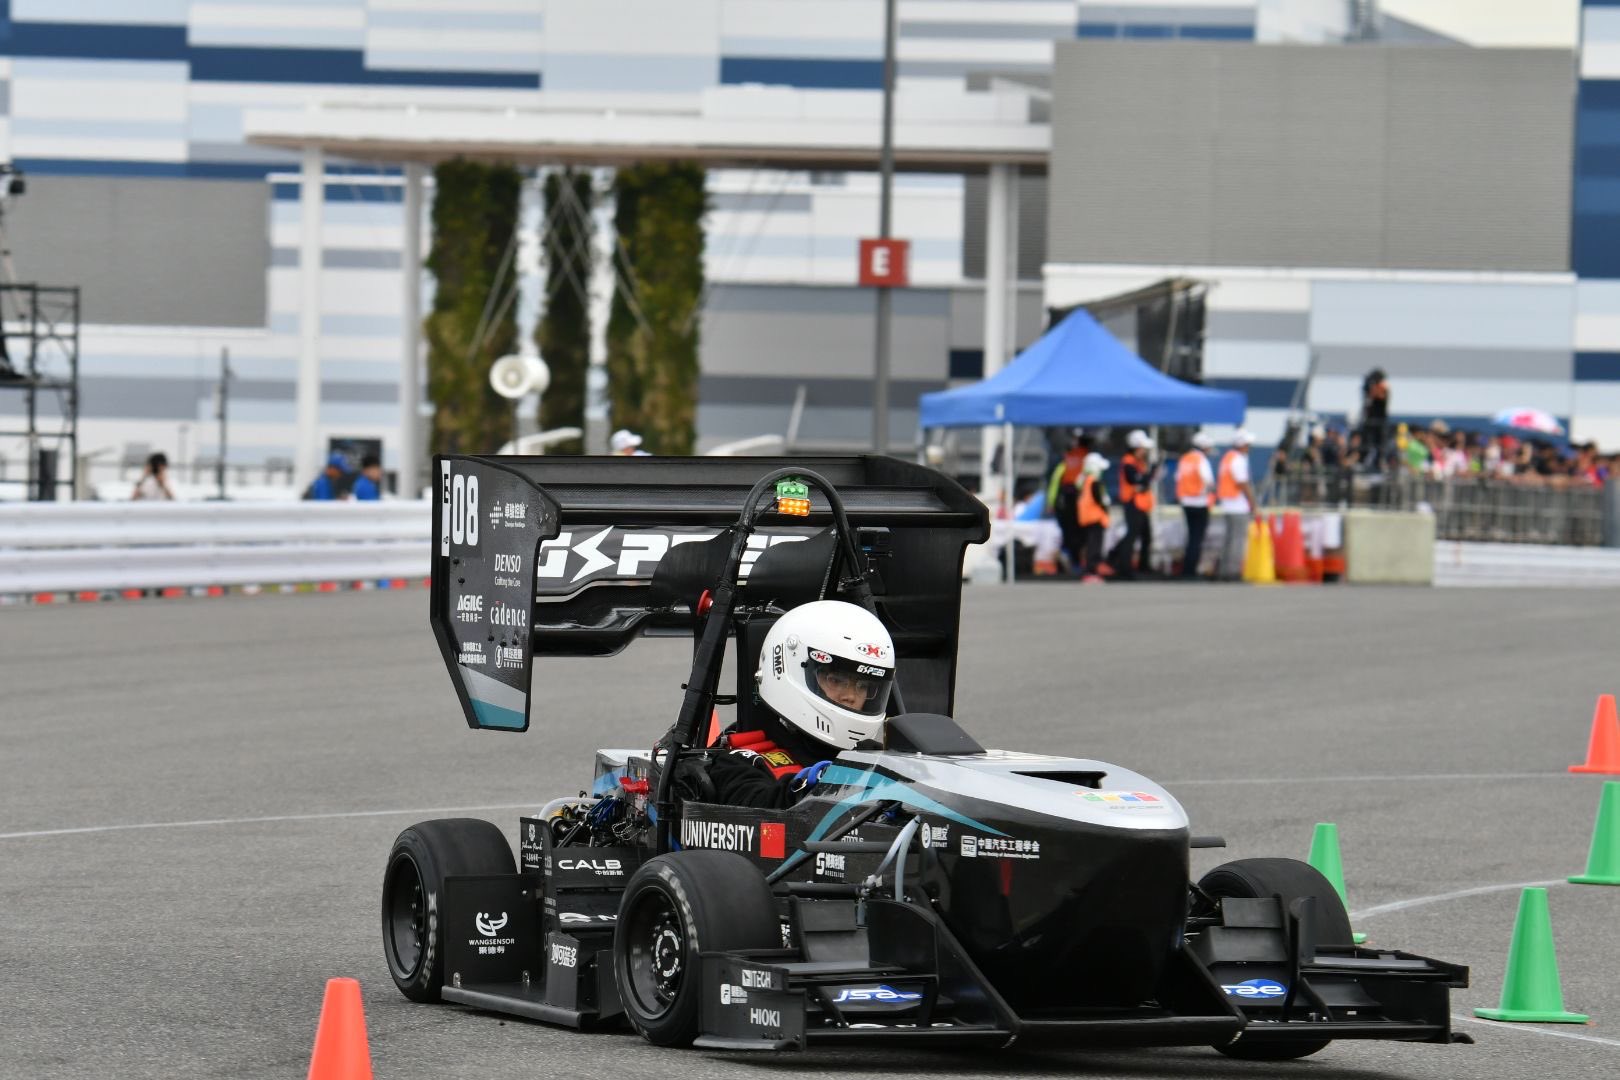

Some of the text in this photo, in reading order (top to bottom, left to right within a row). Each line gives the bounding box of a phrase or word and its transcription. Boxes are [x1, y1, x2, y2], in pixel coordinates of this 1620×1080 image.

[870, 246, 891, 277] E
[452, 473, 479, 546] 08
[494, 553, 521, 573] DENSO
[456, 594, 483, 612] AGILE
[490, 602, 526, 627] cadence
[774, 644, 782, 675] OMP
[684, 819, 755, 852] UNIVERSITY
[977, 838, 1040, 853] 中国汽车工程学会
[558, 859, 622, 870] CALB
[468, 938, 515, 946] WANGSENSOR
[750, 1007, 781, 1028] HIOKI
